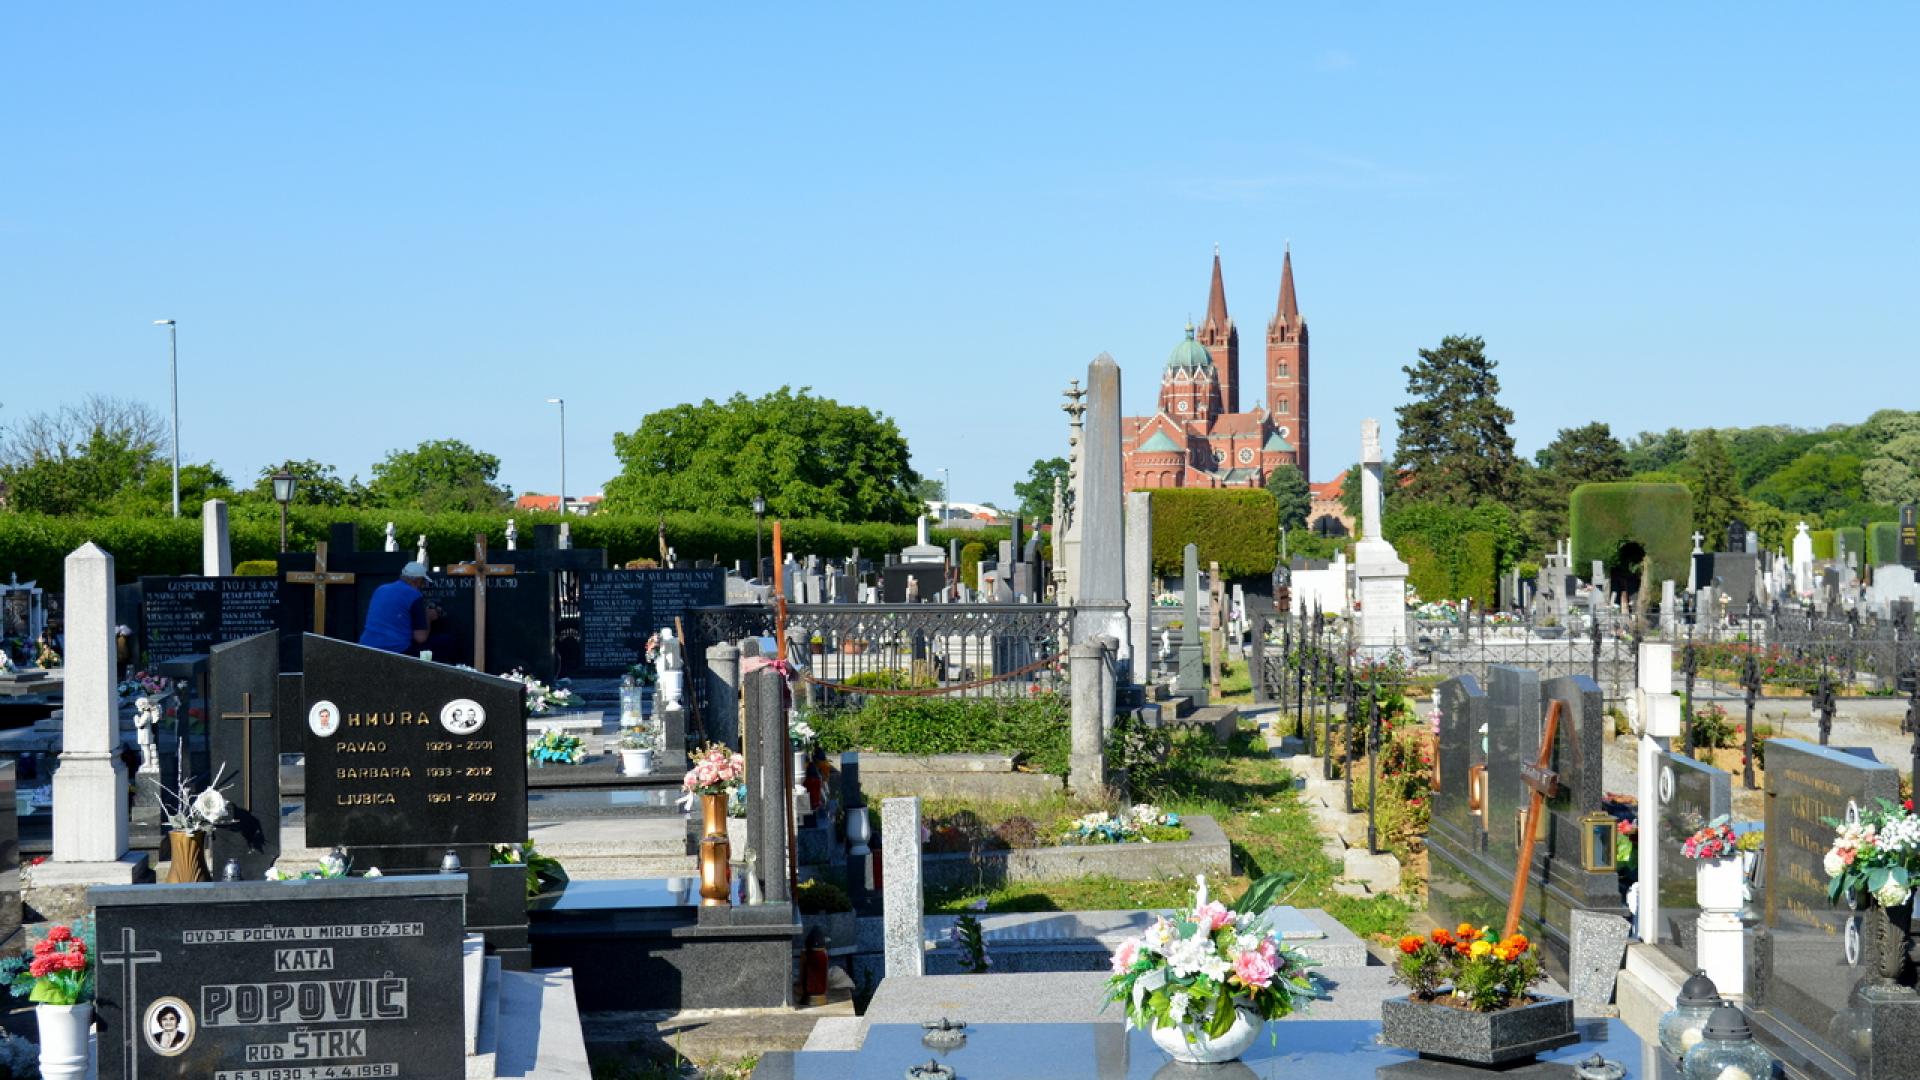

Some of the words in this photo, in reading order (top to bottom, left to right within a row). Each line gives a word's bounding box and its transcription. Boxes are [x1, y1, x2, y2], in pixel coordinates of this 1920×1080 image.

[348, 711, 430, 727] HMURA
[336, 741, 387, 753] PAVAO
[425, 741, 453, 752] 1929
[466, 741, 493, 751] 2001
[336, 766, 411, 779] BARBARA
[426, 767, 453, 777] 1933
[465, 766, 493, 777] 2012
[336, 792, 396, 805] LJUBICA
[467, 791, 497, 803] 2007
[185, 930, 236, 943] OVDJE
[243, 924, 296, 941] POČIVA
[303, 927, 313, 939] U
[319, 926, 354, 939] MIRU
[360, 921, 423, 938] BOŽJEM
[277, 949, 333, 970] KATA
[203, 970, 406, 1025] POPOVIĆ
[248, 1044, 284, 1060] ROĐ
[293, 1026, 364, 1058] ŠTRK
